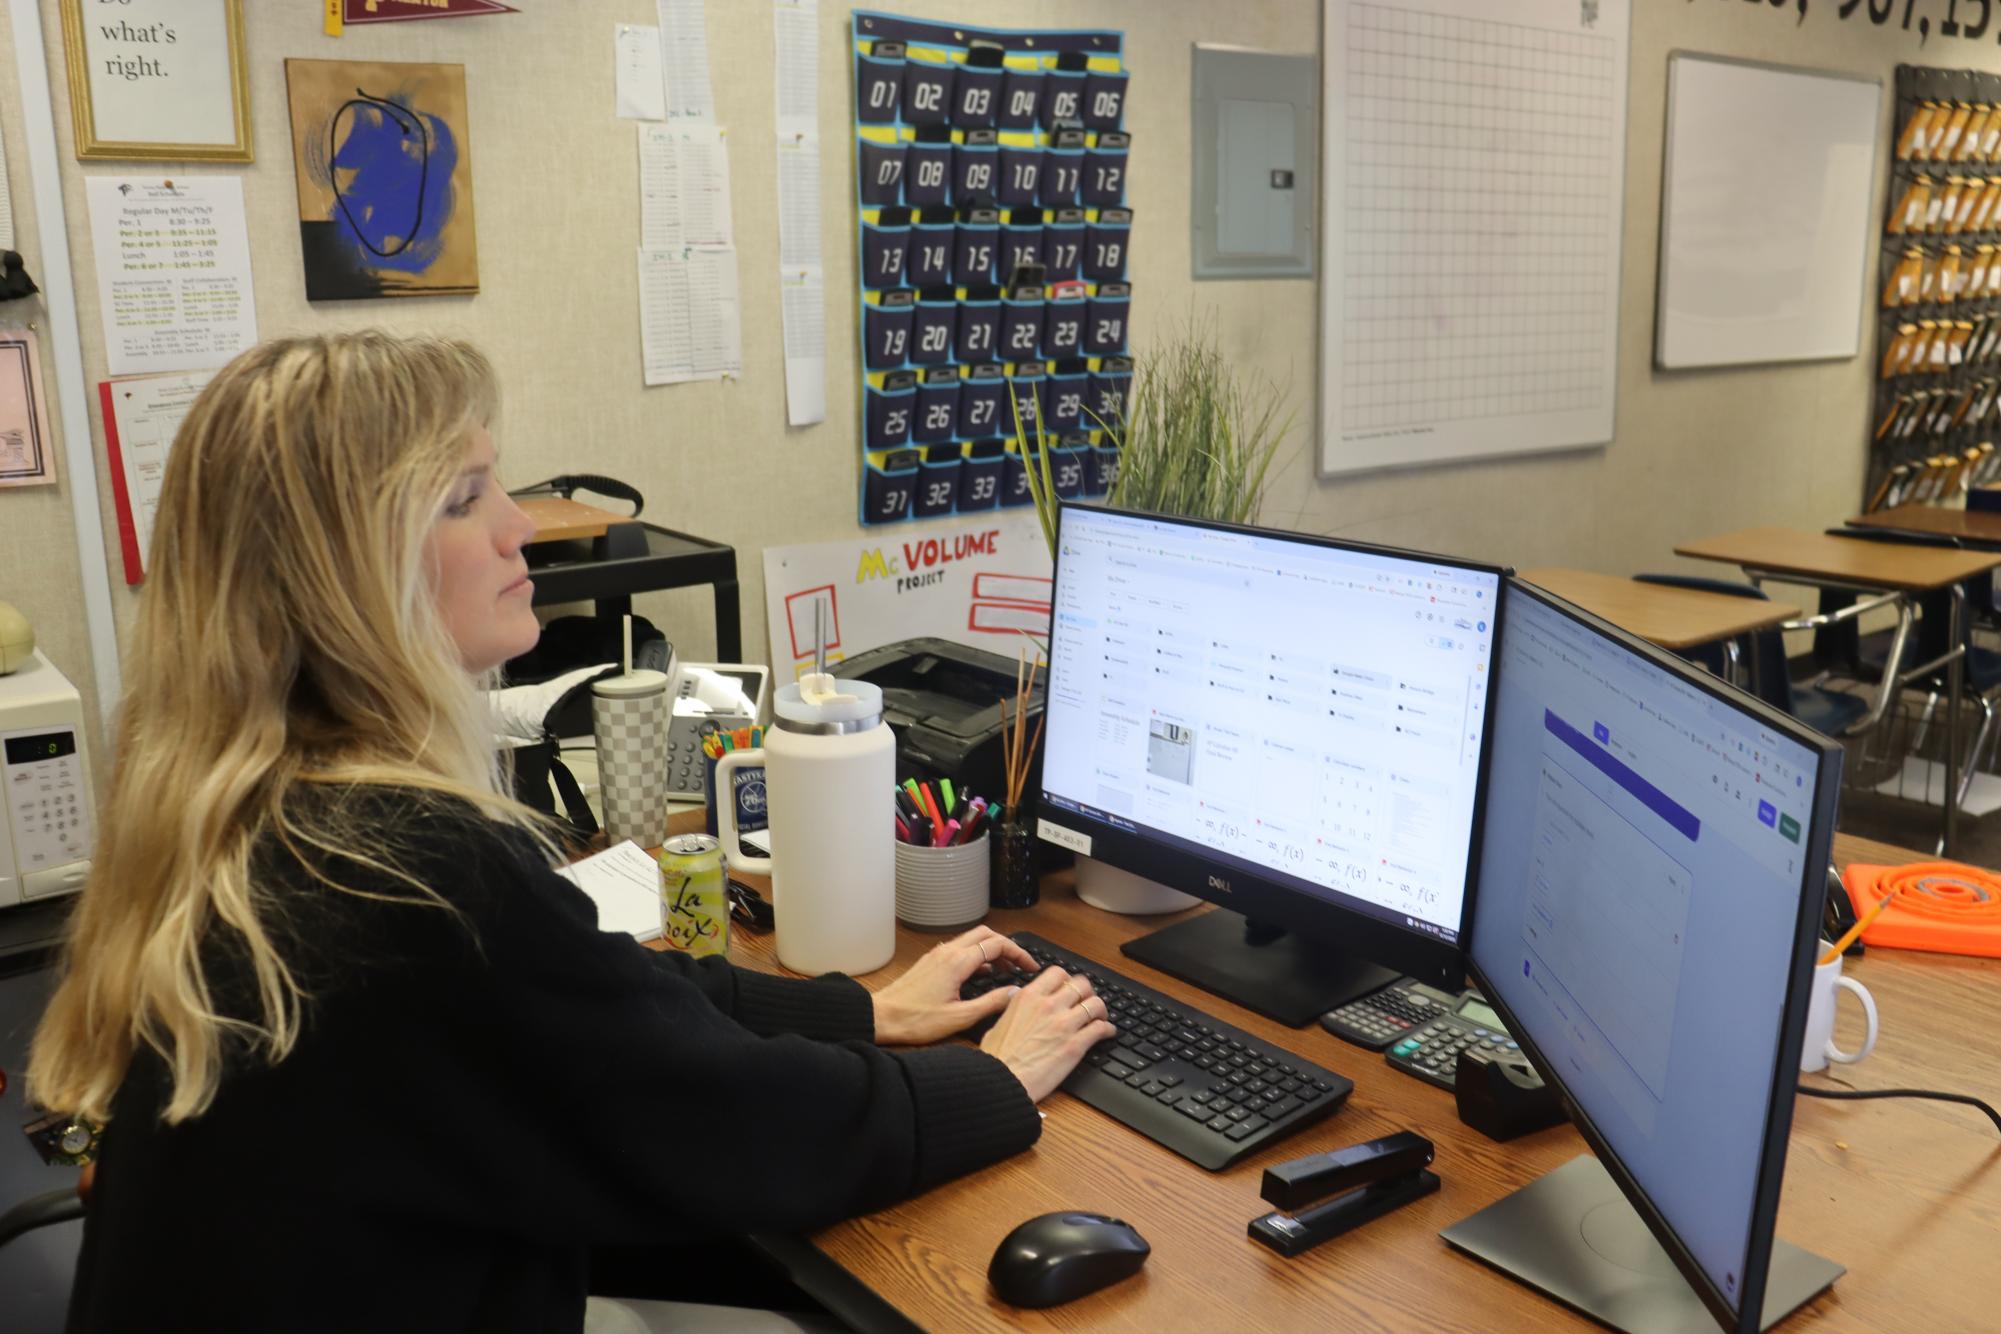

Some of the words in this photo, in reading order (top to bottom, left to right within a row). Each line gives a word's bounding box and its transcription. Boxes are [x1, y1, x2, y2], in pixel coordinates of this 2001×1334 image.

[100, 20, 176, 43] what's
[105, 54, 168, 81] right.
[871, 82, 896, 108] 01
[914, 83, 942, 111] 02
[964, 89, 990, 115] 03
[1010, 91, 1035, 116] 04
[1054, 92, 1077, 117] 05
[1093, 92, 1120, 117] 06
[878, 160, 902, 185] 07
[918, 161, 944, 187] 08
[966, 164, 990, 189] 09
[1014, 164, 1036, 190] 10
[1057, 168, 1078, 192] 11
[1097, 168, 1119, 192] 12
[881, 249, 902, 274] 13
[923, 246, 945, 272] 14
[968, 247, 991, 272] 15
[1055, 245, 1077, 269] 17
[1097, 244, 1120, 268] 18
[884, 329, 906, 355] 19
[922, 326, 947, 351] 20
[968, 323, 991, 349] 21
[1012, 323, 1036, 348] 22
[1055, 322, 1078, 346] 23
[1096, 320, 1121, 343] 24
[885, 410, 908, 435] 25
[926, 405, 951, 429] 26
[970, 400, 995, 424] 27
[1057, 394, 1080, 417] 29
[882, 490, 907, 514] 31
[926, 482, 951, 506] 32
[972, 476, 996, 500] 33
[1057, 465, 1081, 488] 35
[897, 570, 945, 594] PROJECT
[670, 877, 702, 918] La
[1208, 875, 1233, 893] DELL
